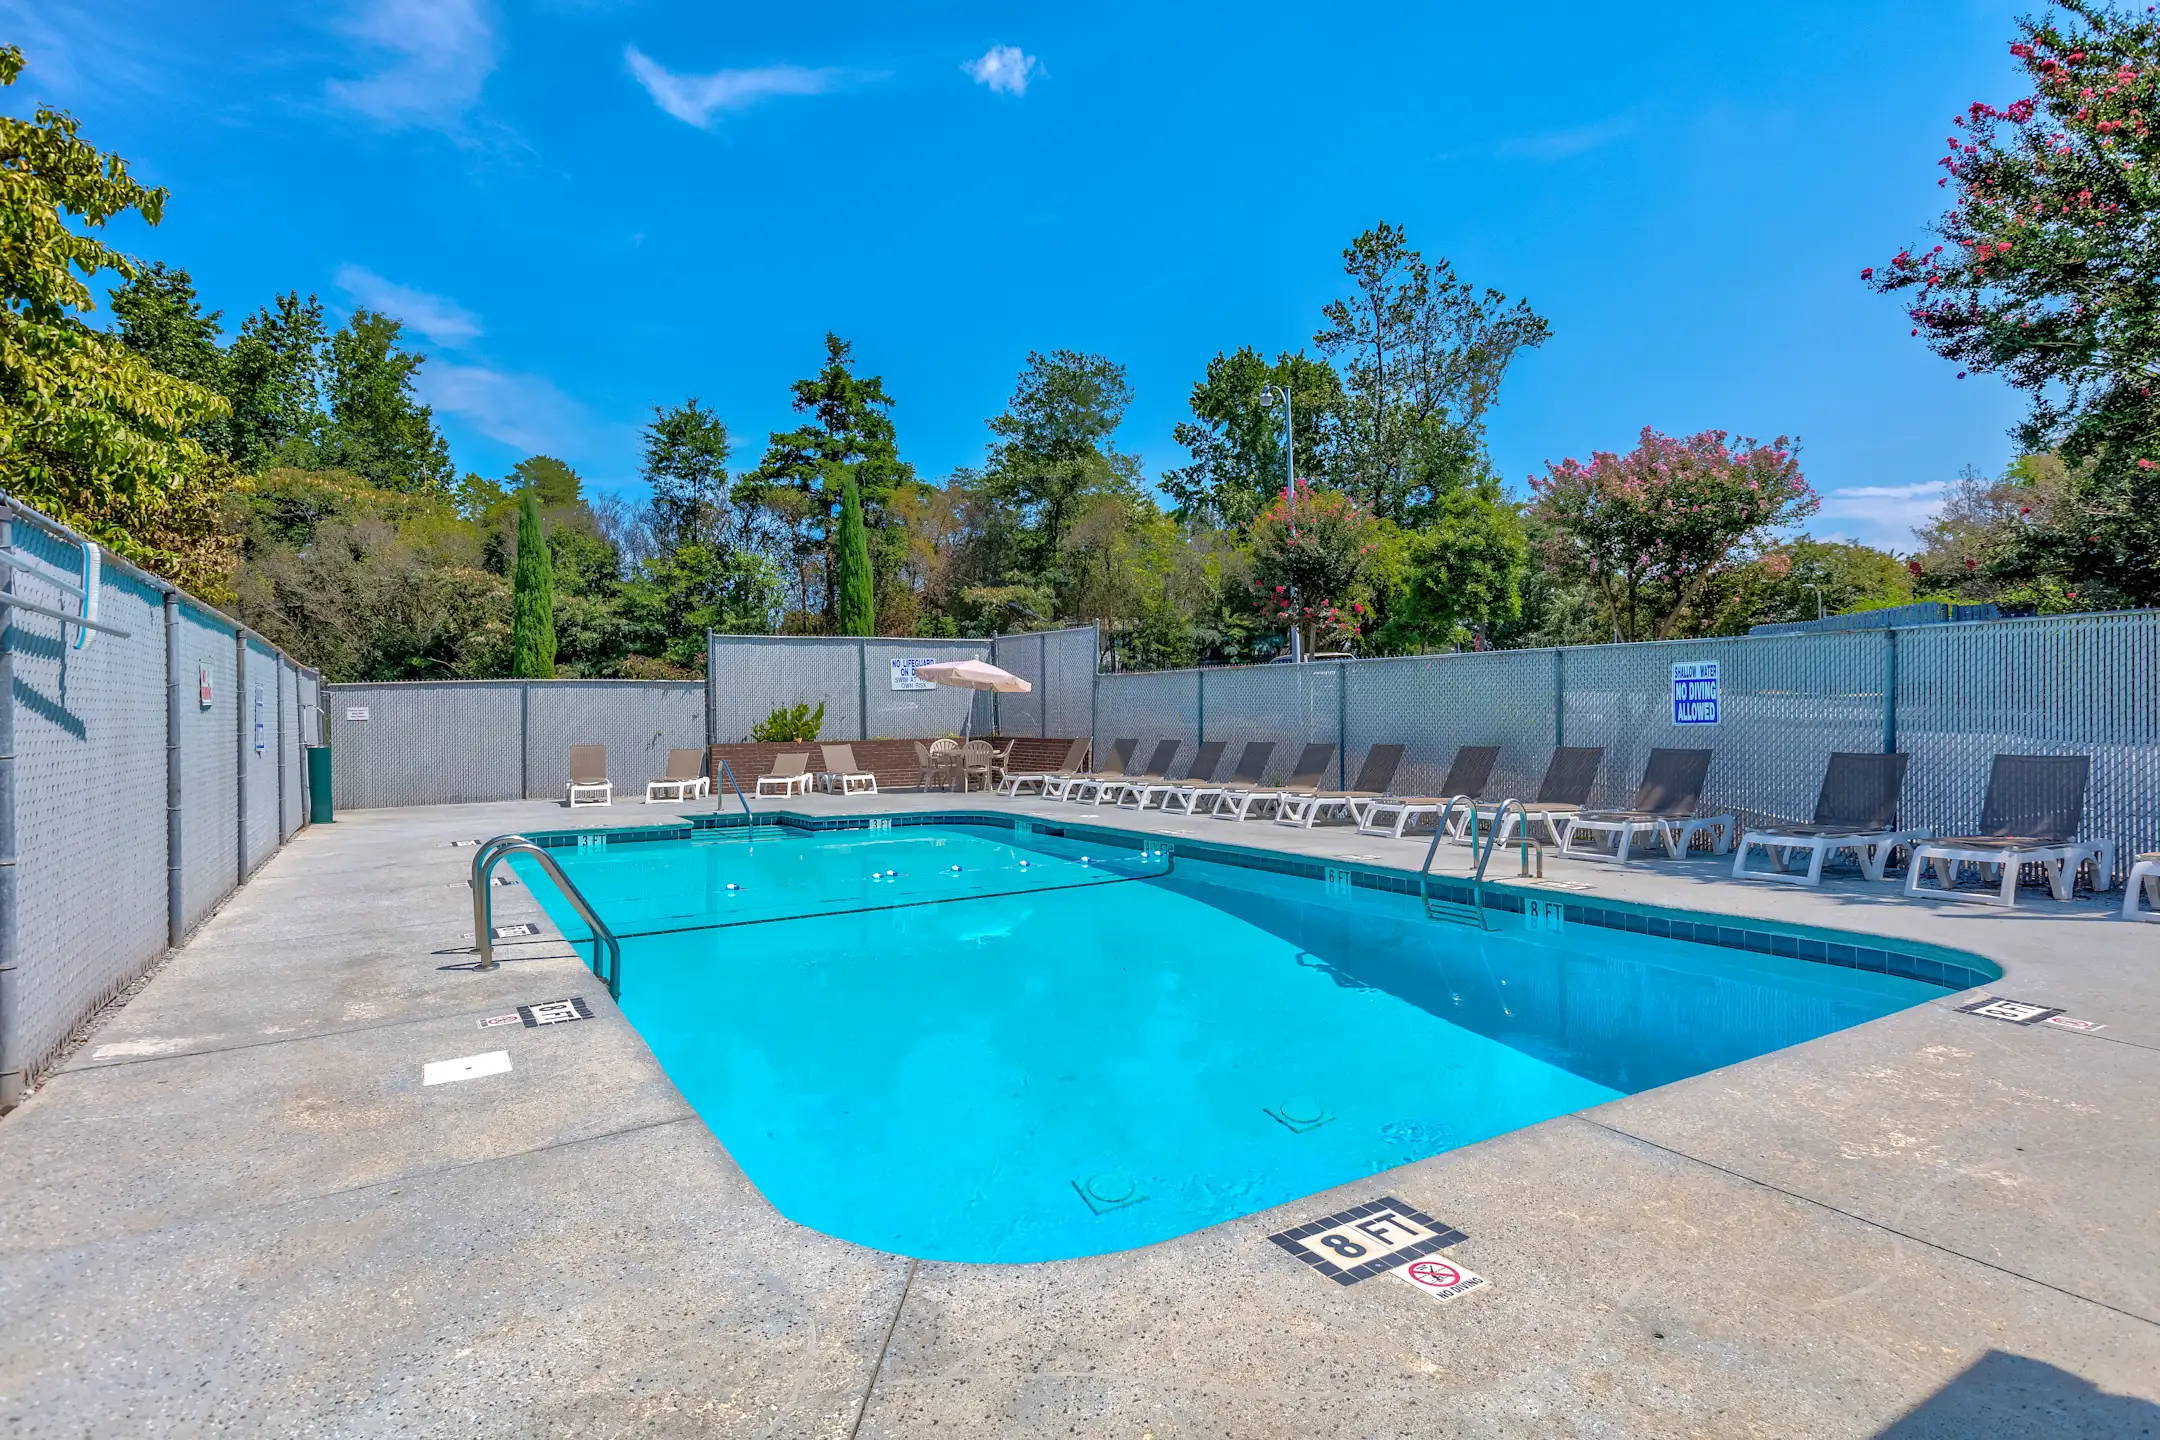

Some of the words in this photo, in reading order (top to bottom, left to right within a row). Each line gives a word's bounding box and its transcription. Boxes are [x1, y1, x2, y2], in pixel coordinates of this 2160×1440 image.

[901, 668, 909, 676] ON
[1675, 665, 1697, 678] SHALLOW
[1700, 664, 1717, 677] WATER
[1675, 682, 1687, 700] NO
[1688, 681, 1717, 700] DIVING
[1677, 702, 1716, 721] ALLOWED
[582, 835, 588, 846] 3
[1339, 871, 1350, 885] FT
[1531, 900, 1539, 917] 8
[1545, 902, 1563, 920] FT
[1985, 1009, 2018, 1018] 8
[1995, 1003, 2036, 1013] FT
[542, 1011, 574, 1020] FT
[1320, 1234, 1367, 1258] 8
[1355, 1212, 1420, 1246] FT
[1436, 1289, 1454, 1300] NO
[1450, 1277, 1484, 1293] DIVING
